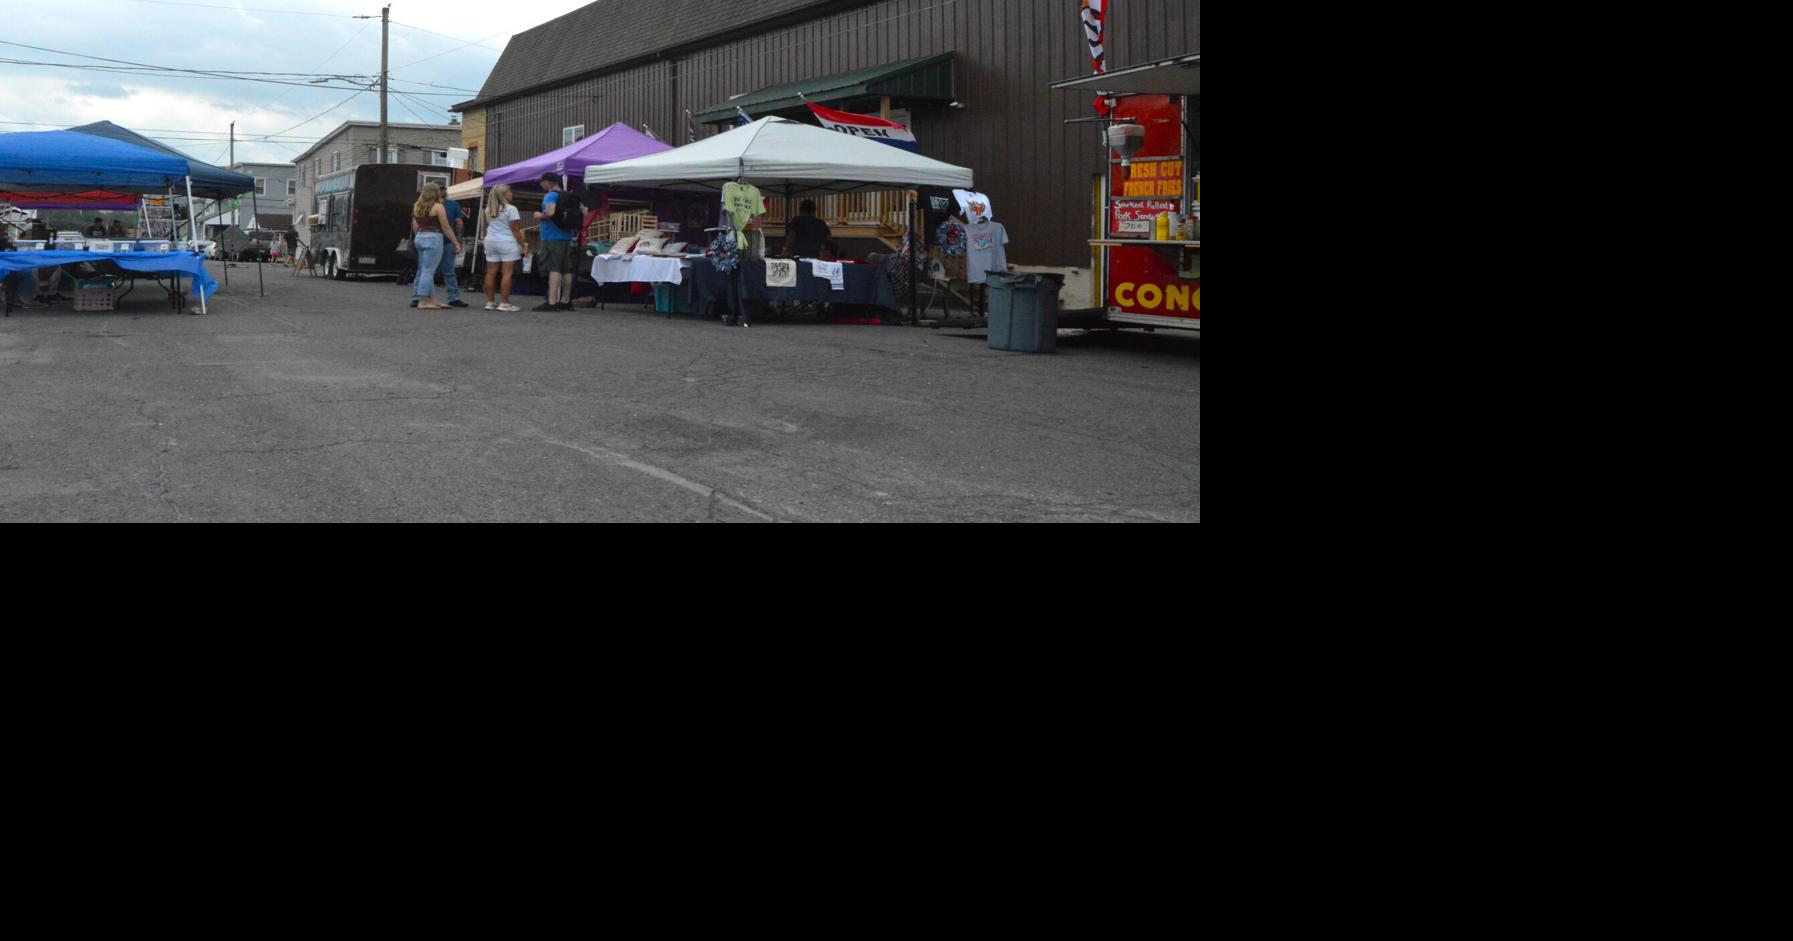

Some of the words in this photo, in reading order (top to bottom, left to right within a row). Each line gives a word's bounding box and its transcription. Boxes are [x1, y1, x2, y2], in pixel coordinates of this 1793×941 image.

[833, 123, 891, 138] OPEN
[1129, 161, 1157, 178] RESH
[1160, 160, 1182, 177] CUT
[1123, 180, 1155, 196] FRENCH
[1157, 179, 1182, 196] FRIES
[1114, 209, 1132, 221] Pork
